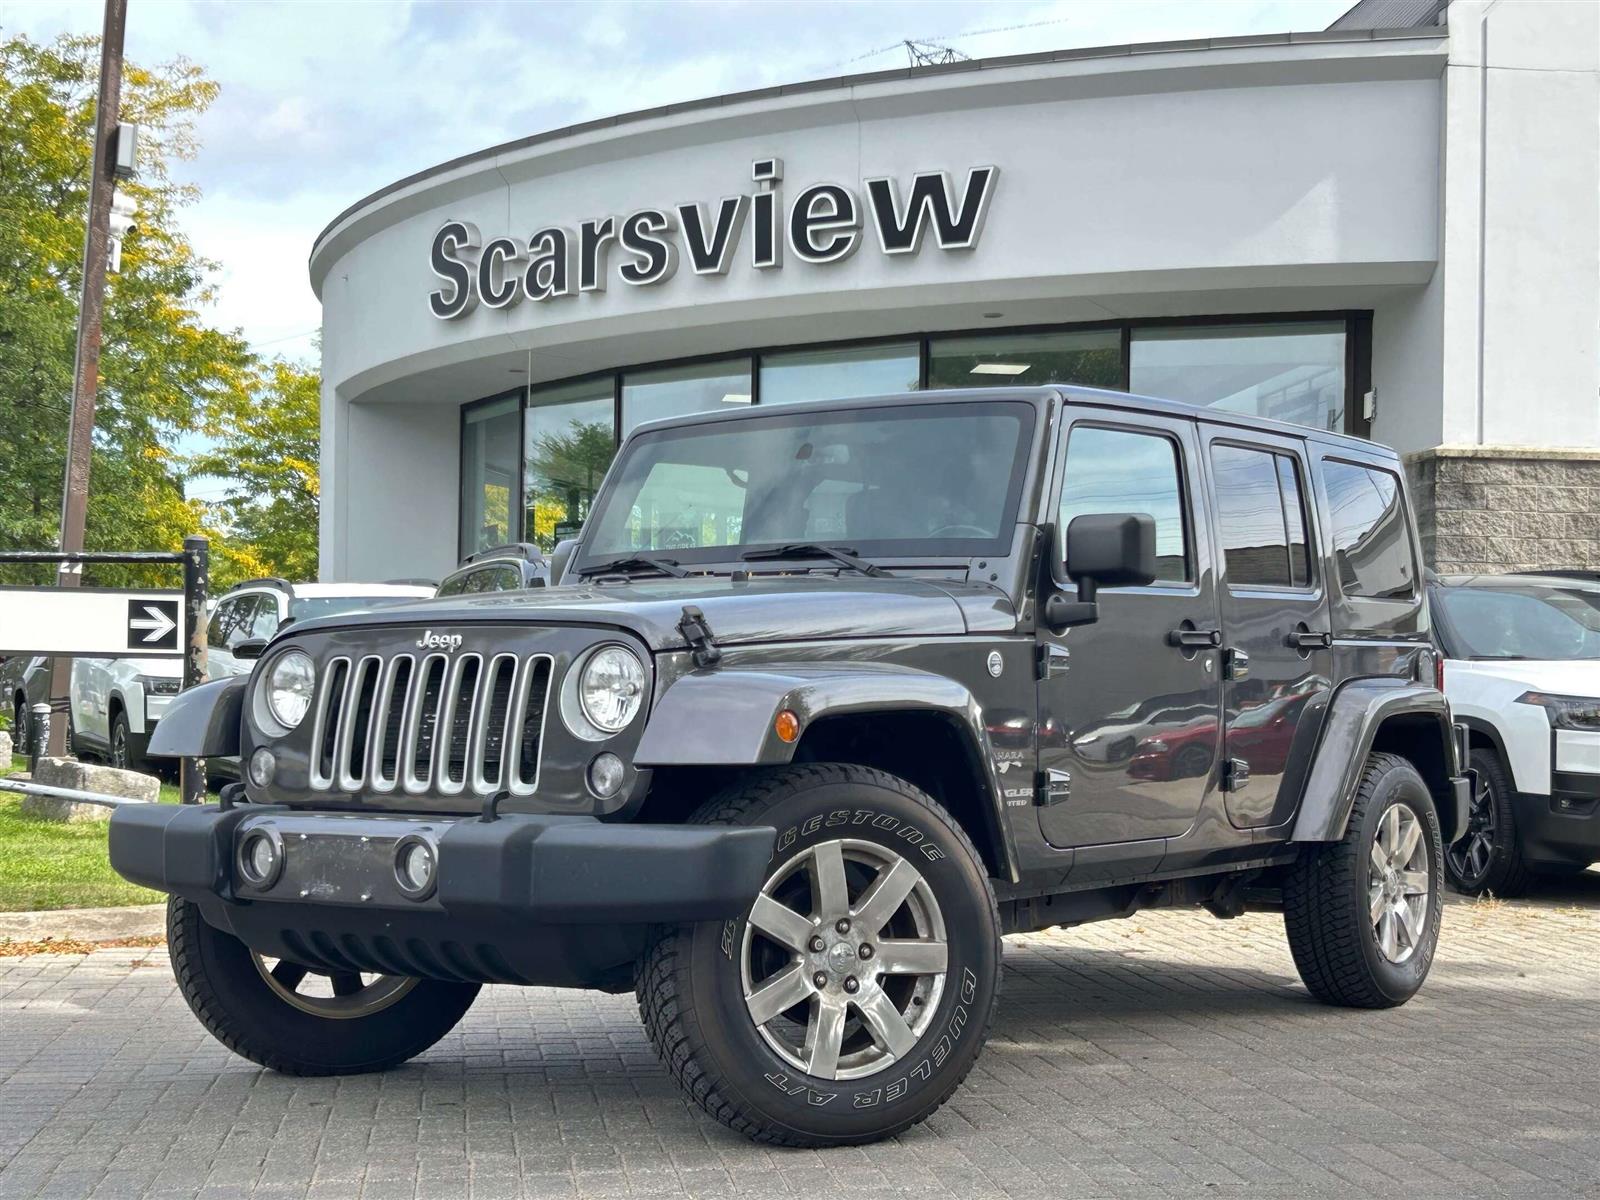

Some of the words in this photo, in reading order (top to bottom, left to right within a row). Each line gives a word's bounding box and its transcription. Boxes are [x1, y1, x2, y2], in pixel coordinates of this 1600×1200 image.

[429, 158, 999, 321] Scarsview
[416, 630, 463, 653] Jeep
[1004, 788, 1034, 797] GLER
[852, 967, 977, 1108] DUELER
[764, 1071, 837, 1106] A/T
